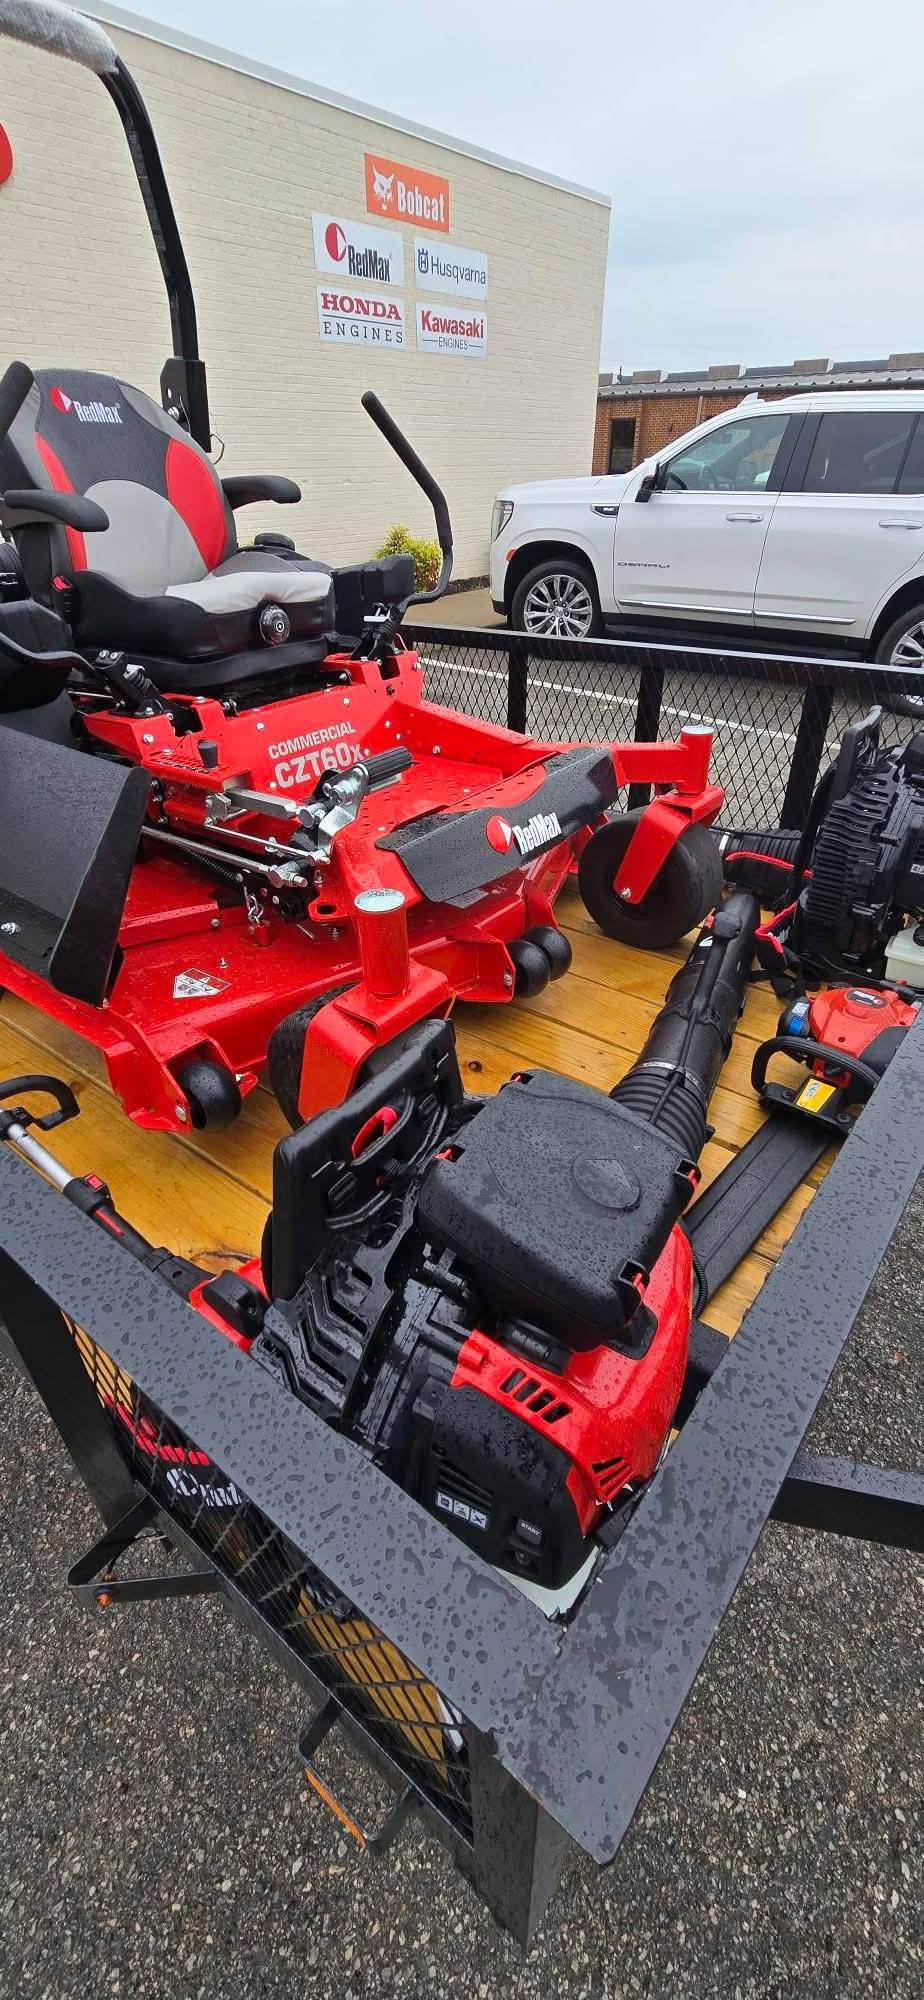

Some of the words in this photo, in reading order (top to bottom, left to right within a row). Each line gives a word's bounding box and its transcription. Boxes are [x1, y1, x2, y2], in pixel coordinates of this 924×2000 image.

[397, 181, 445, 223] Bobcat
[348, 245, 391, 282] RedMax
[431, 255, 486, 285] Husqvarna
[321, 292, 402, 321] HONDA
[323, 321, 403, 344] ENGINES
[421, 310, 484, 338] Kawasaki
[438, 334, 469, 351] ENGINES
[72, 400, 122, 423] RedMax
[268, 721, 357, 759] COMMERCIAL
[512, 811, 562, 856] RedMax
[521, 1522, 540, 1536] START
